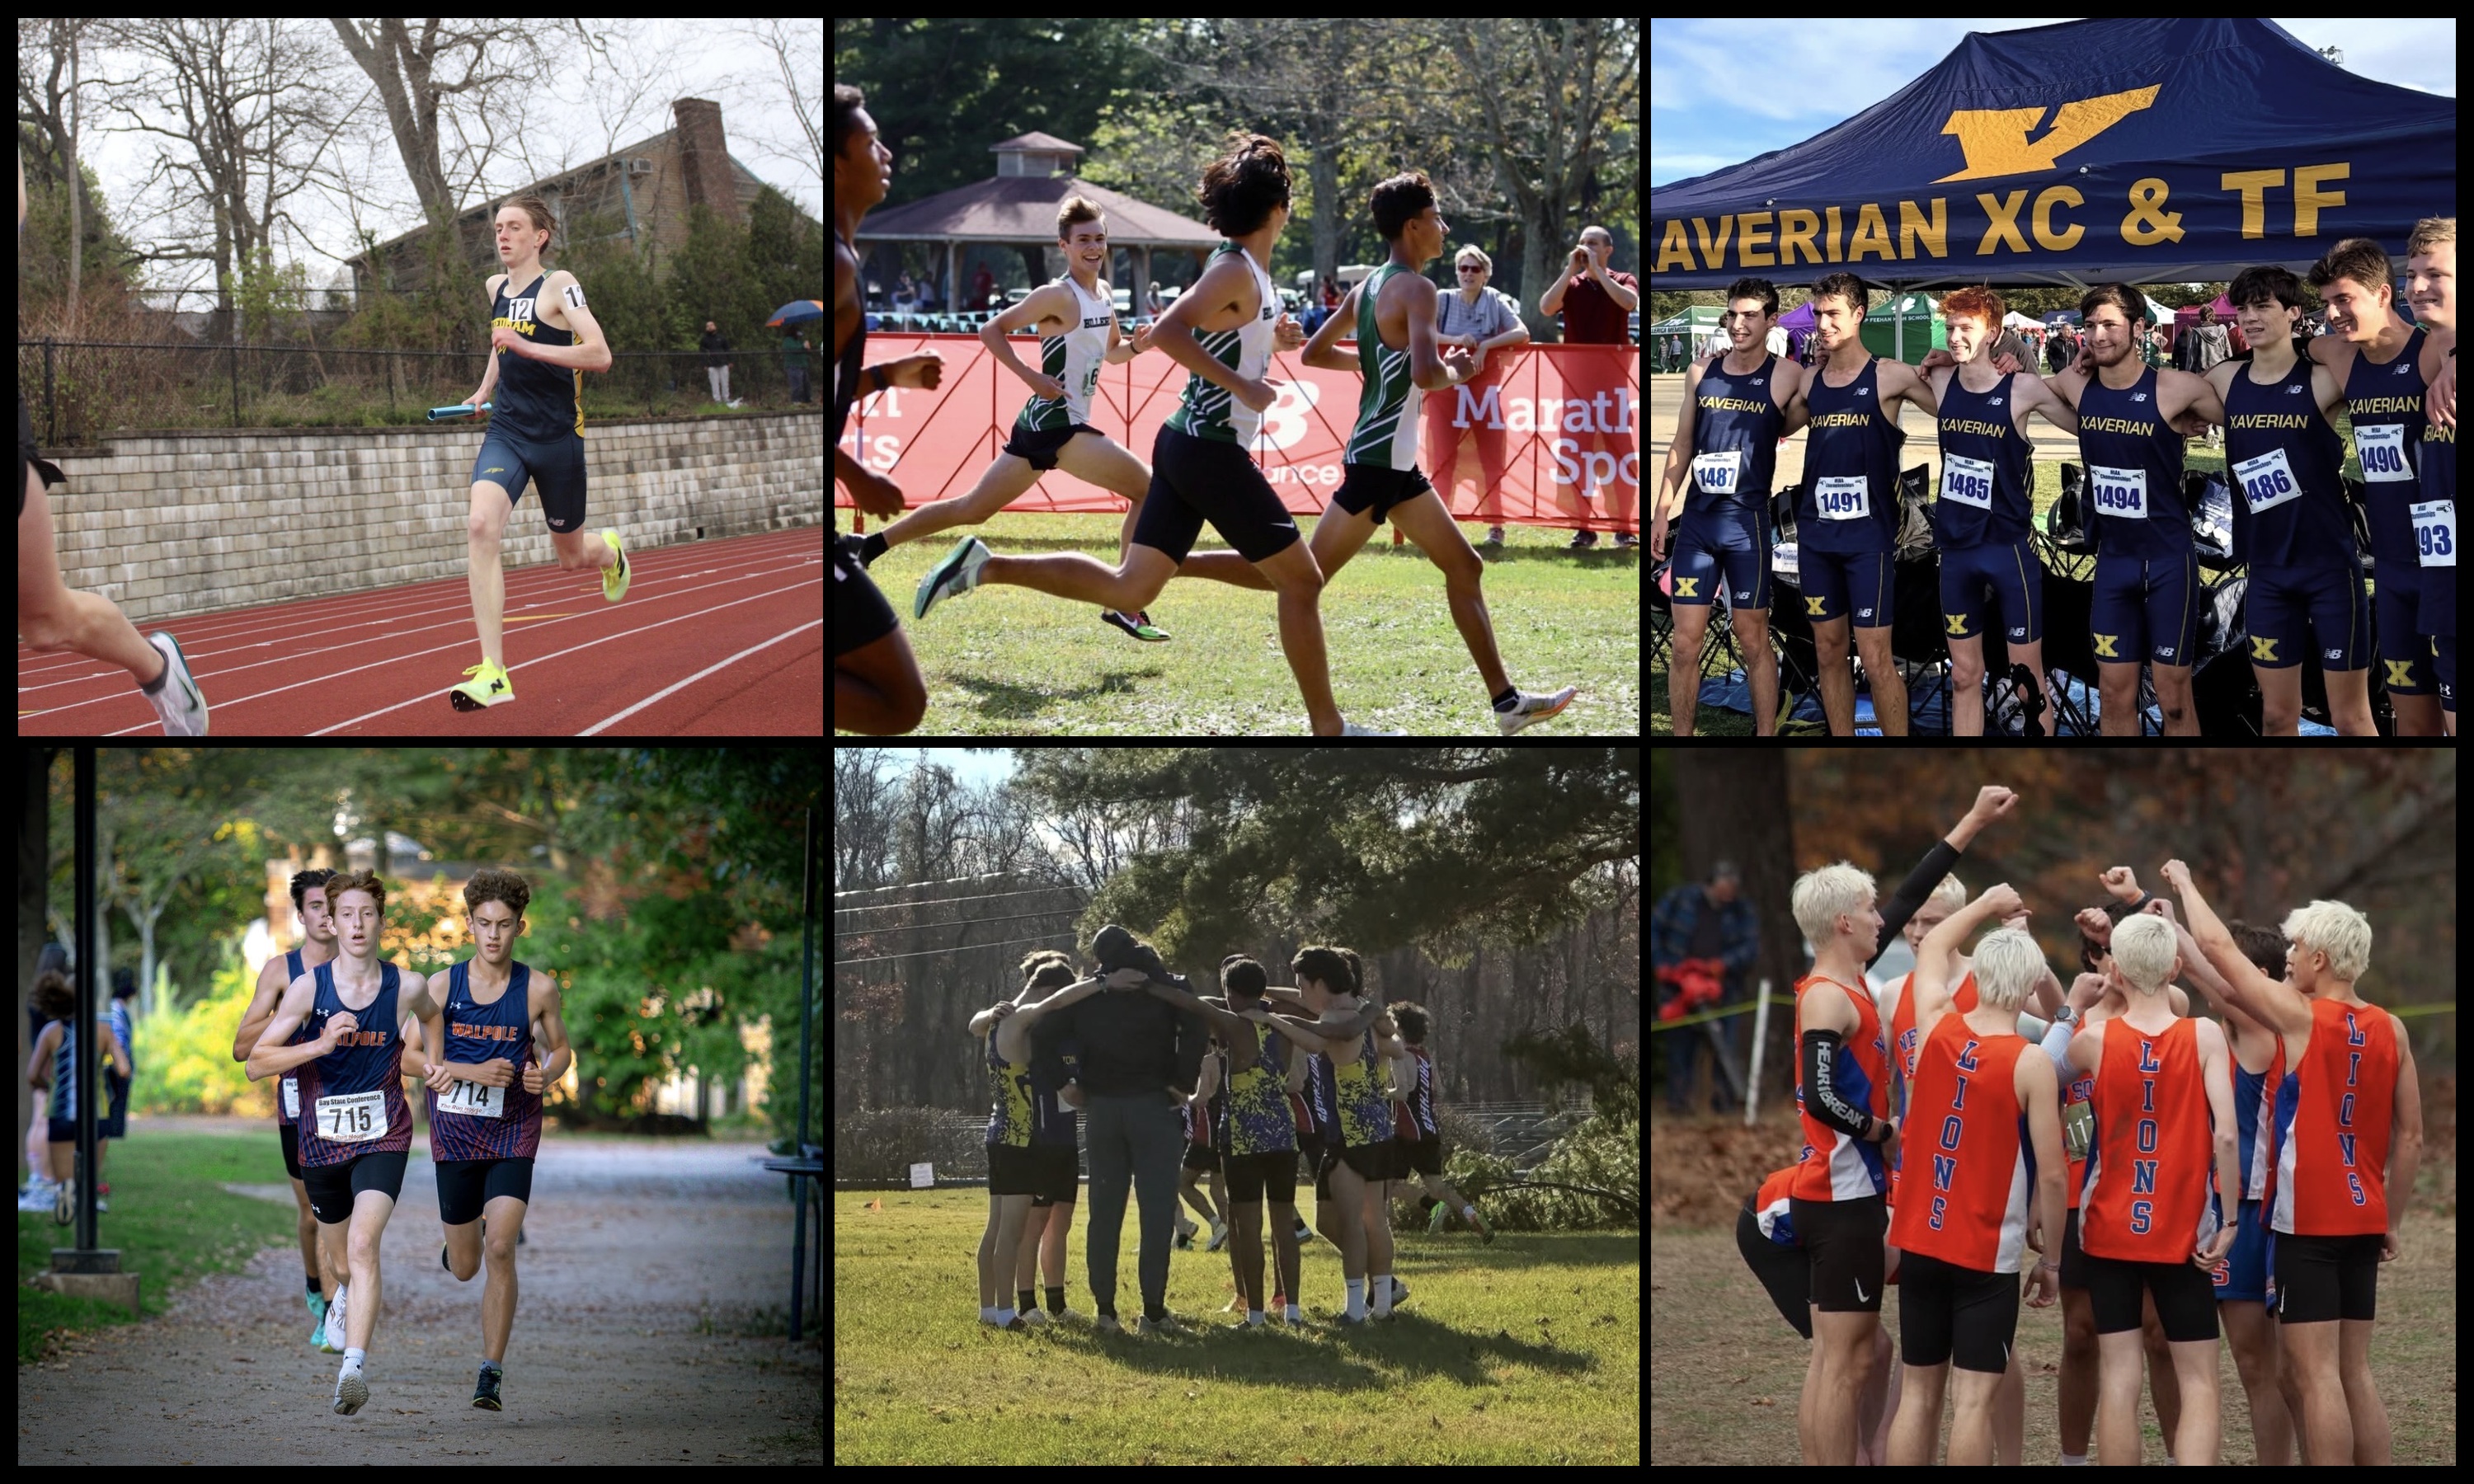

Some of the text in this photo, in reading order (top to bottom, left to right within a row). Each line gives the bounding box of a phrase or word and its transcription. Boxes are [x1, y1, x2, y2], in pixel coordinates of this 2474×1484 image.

[1651, 162, 2350, 273] AVERIAN XC & TF
[511, 299, 529, 321] 12
[1698, 396, 1766, 414] XAVERIAN
[2348, 396, 2420, 416] XAVERIAN
[1810, 414, 1870, 429] XAVERIAN
[1940, 418, 2006, 439] XAVERIAN
[2081, 416, 2155, 437] XAVERIAN
[2230, 414, 2308, 430] XAVERIAN
[2359, 445, 2403, 473] 1490
[1699, 467, 1737, 486] 1487
[1947, 472, 1989, 500] 1485
[1821, 491, 1863, 513] 1491
[2095, 484, 2142, 510] 1494
[1675, 577, 1699, 597] X
[1804, 595, 1827, 615] X
[1945, 613, 1968, 634] X
[2093, 632, 2119, 657] X
[2250, 634, 2279, 661] X
[2383, 659, 2416, 687] X
[319, 1027, 387, 1047] LPOLE
[451, 1021, 518, 1042] WALPOLE
[346, 1094, 381, 1103] Conference
[451, 1080, 489, 1106] 714
[329, 1106, 371, 1134] 715
[1929, 1040, 1979, 1231] LIONS
[2067, 1115, 2093, 1148] 11
[2130, 1040, 2161, 1235] LIONS
